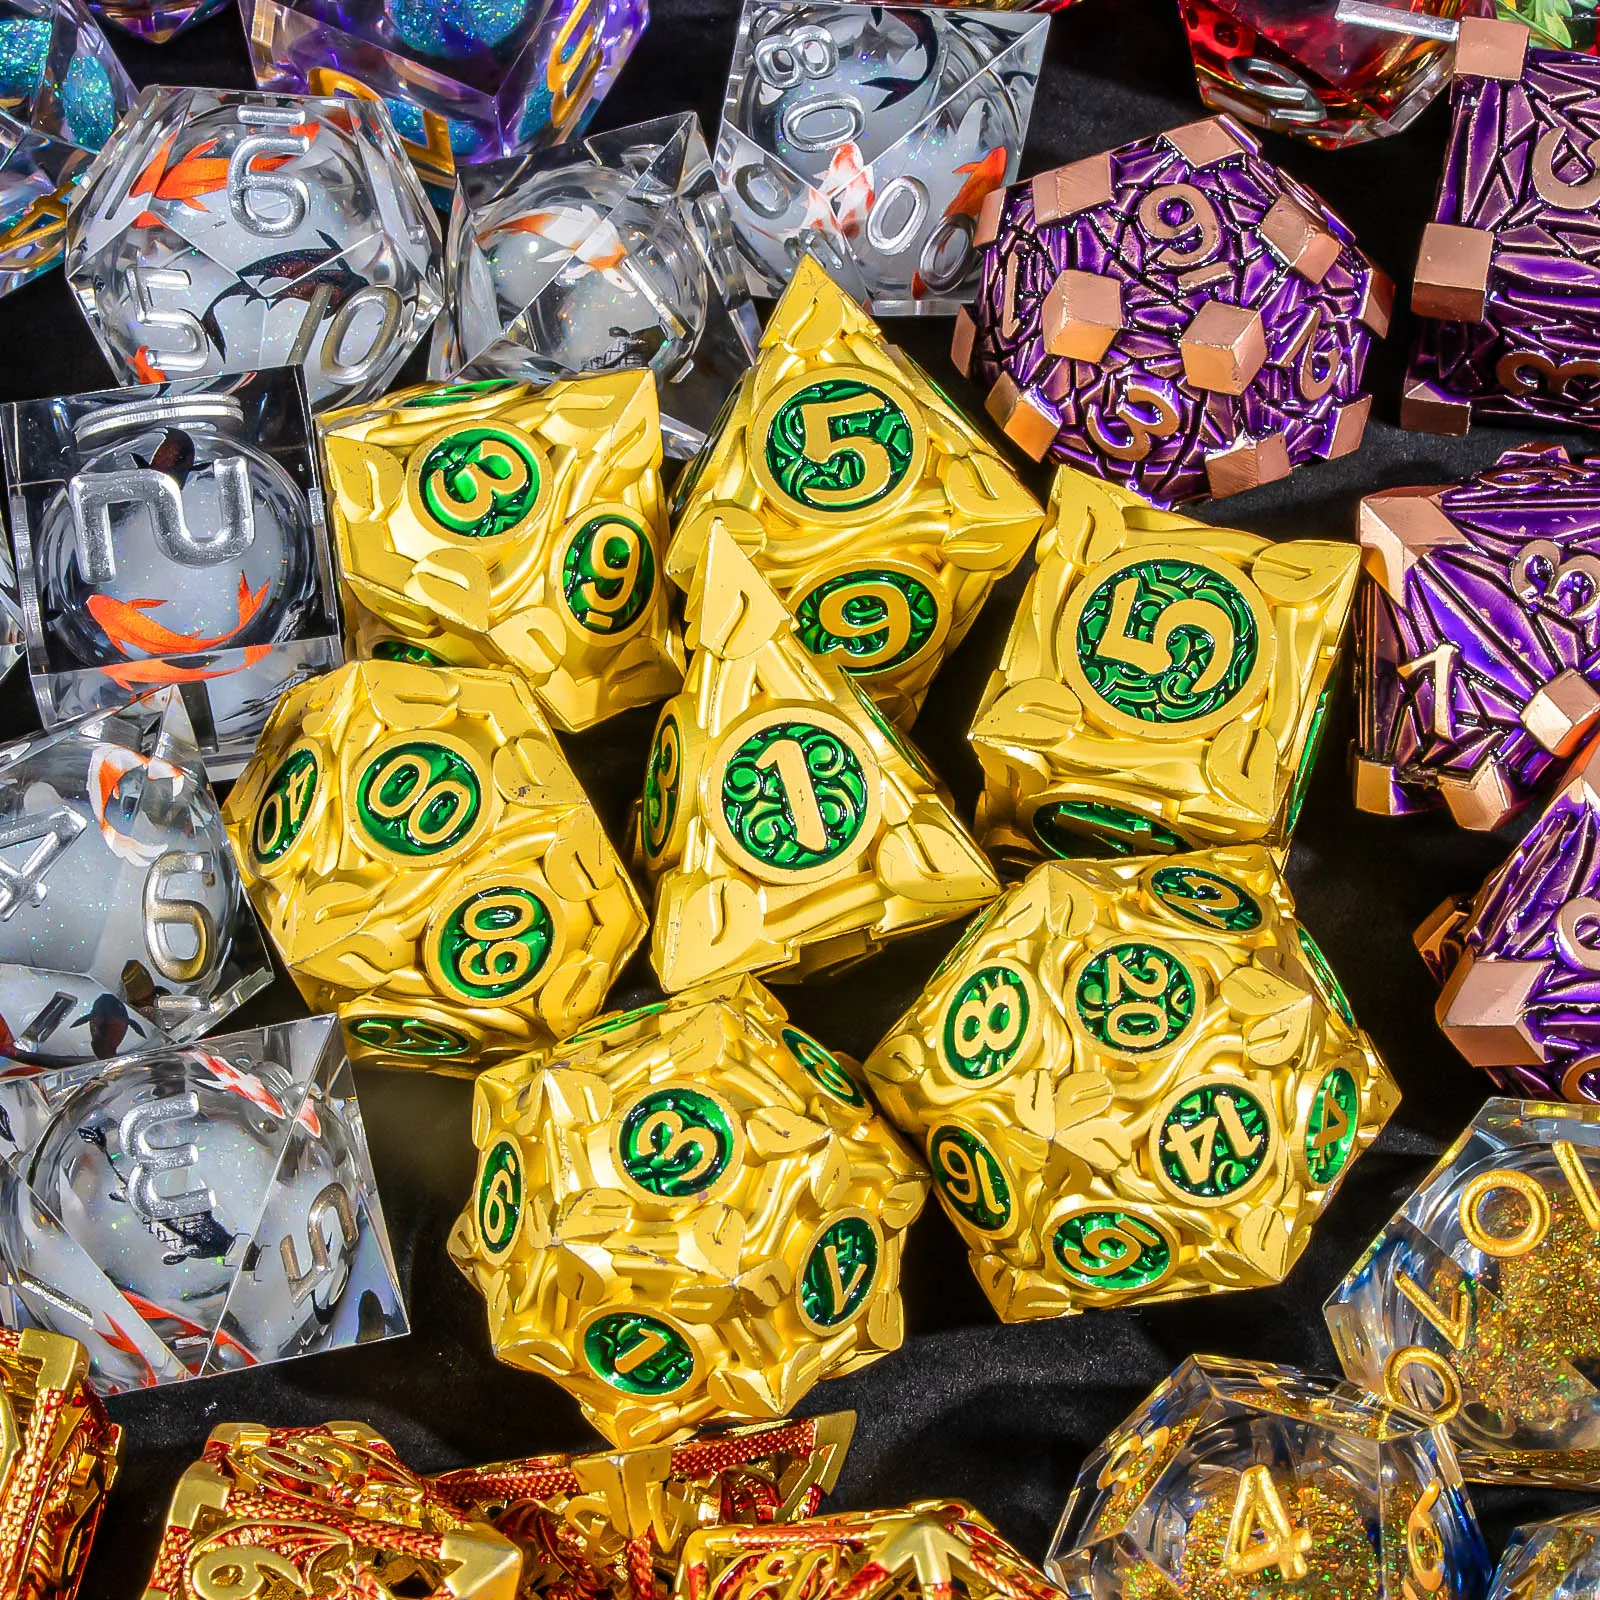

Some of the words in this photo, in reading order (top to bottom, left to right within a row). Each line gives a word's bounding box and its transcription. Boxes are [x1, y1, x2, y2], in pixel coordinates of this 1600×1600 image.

[126, 266, 209, 372] 5
[800, 393, 893, 506] 5
[1086, 386, 1181, 461] 3
[430, 440, 528, 523] 3
[1097, 577, 1235, 693] 5
[1397, 643, 1459, 741] 1
[369, 754, 469, 846] 00
[755, 740, 828, 851] 1
[956, 985, 1021, 1058] 8
[1107, 956, 1169, 1045] 20
[640, 1111, 719, 1181] 3
[1165, 1094, 1261, 1185] 14
[615, 1330, 666, 1374] 1
[1229, 1465, 1312, 1579] 4
